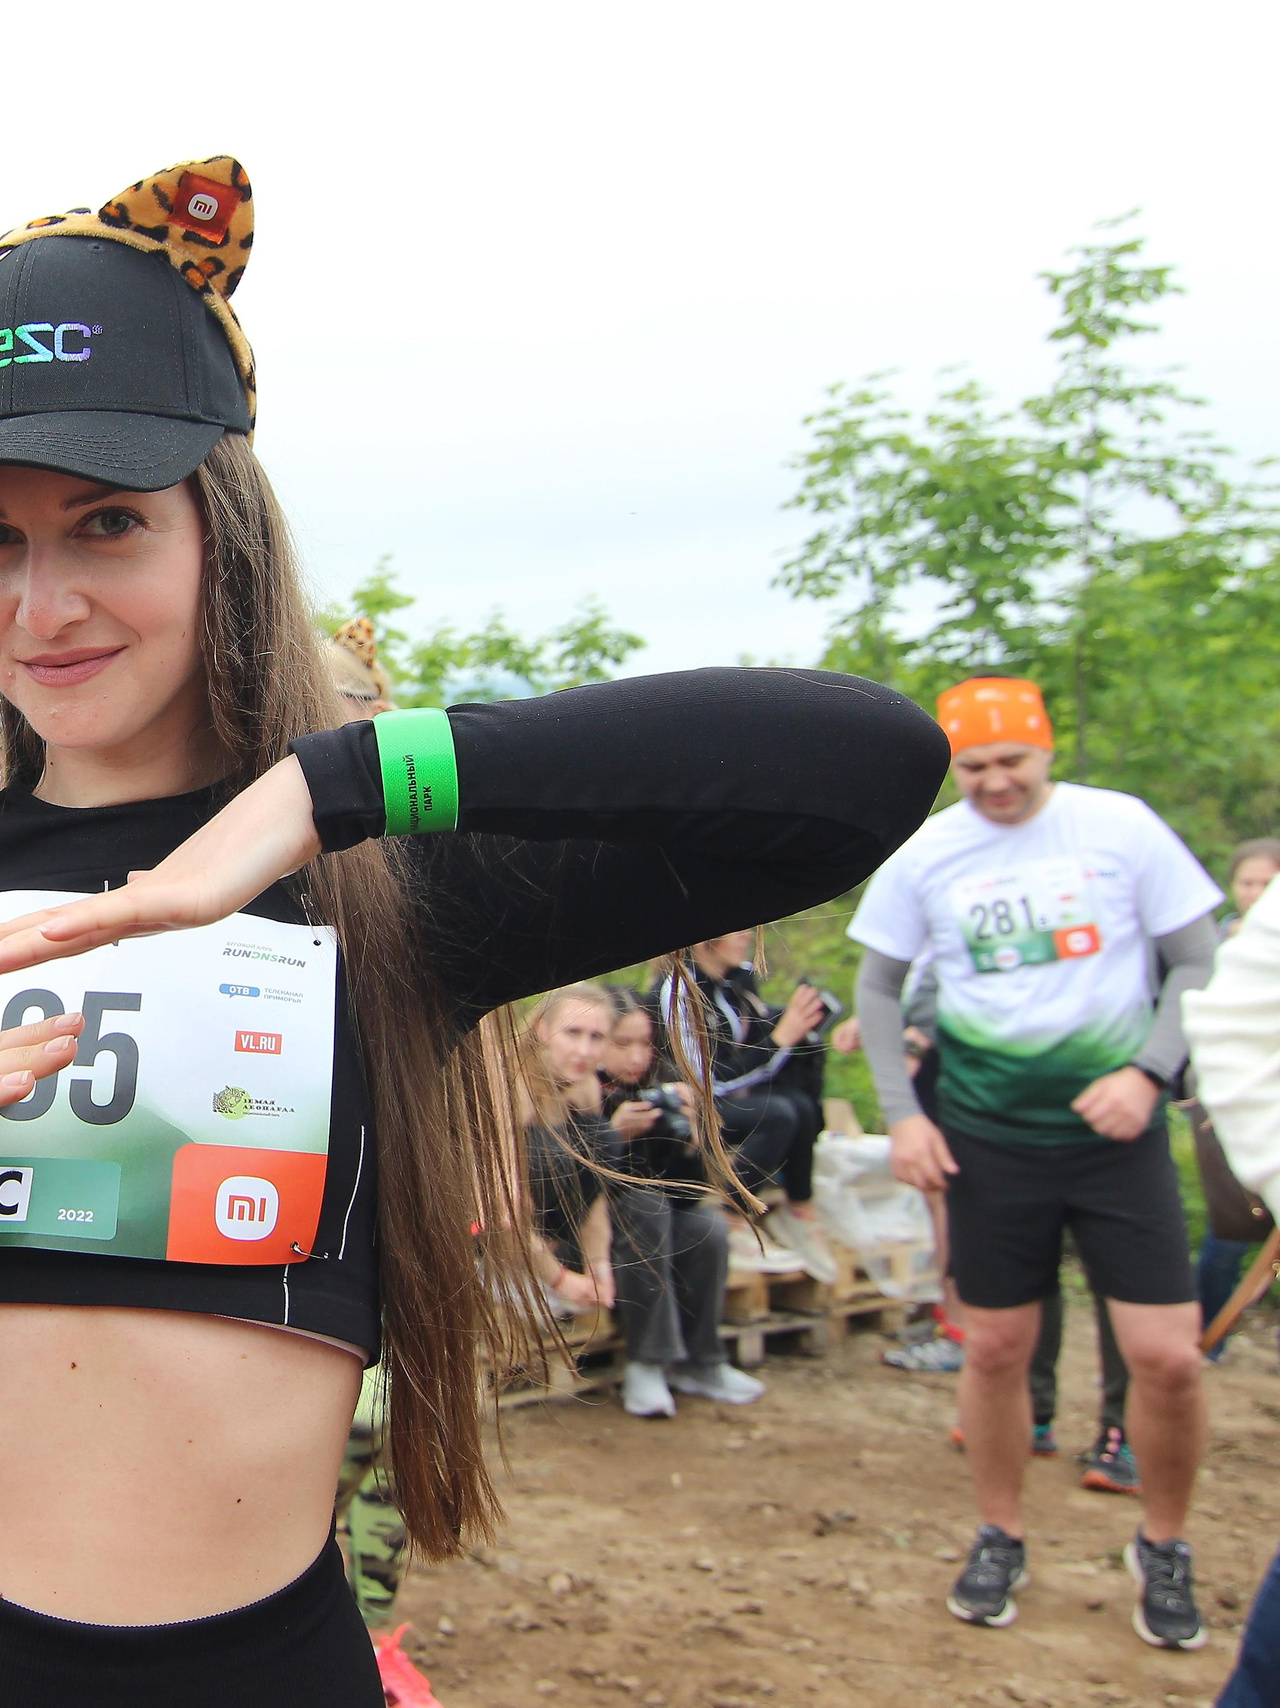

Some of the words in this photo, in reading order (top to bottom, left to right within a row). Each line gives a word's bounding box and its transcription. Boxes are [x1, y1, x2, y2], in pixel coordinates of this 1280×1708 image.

[423, 785, 433, 812] ПАРК
[970, 895, 1035, 941] 281
[240, 1034, 277, 1051] VL.RU
[56, 1207, 94, 1223] 2022
